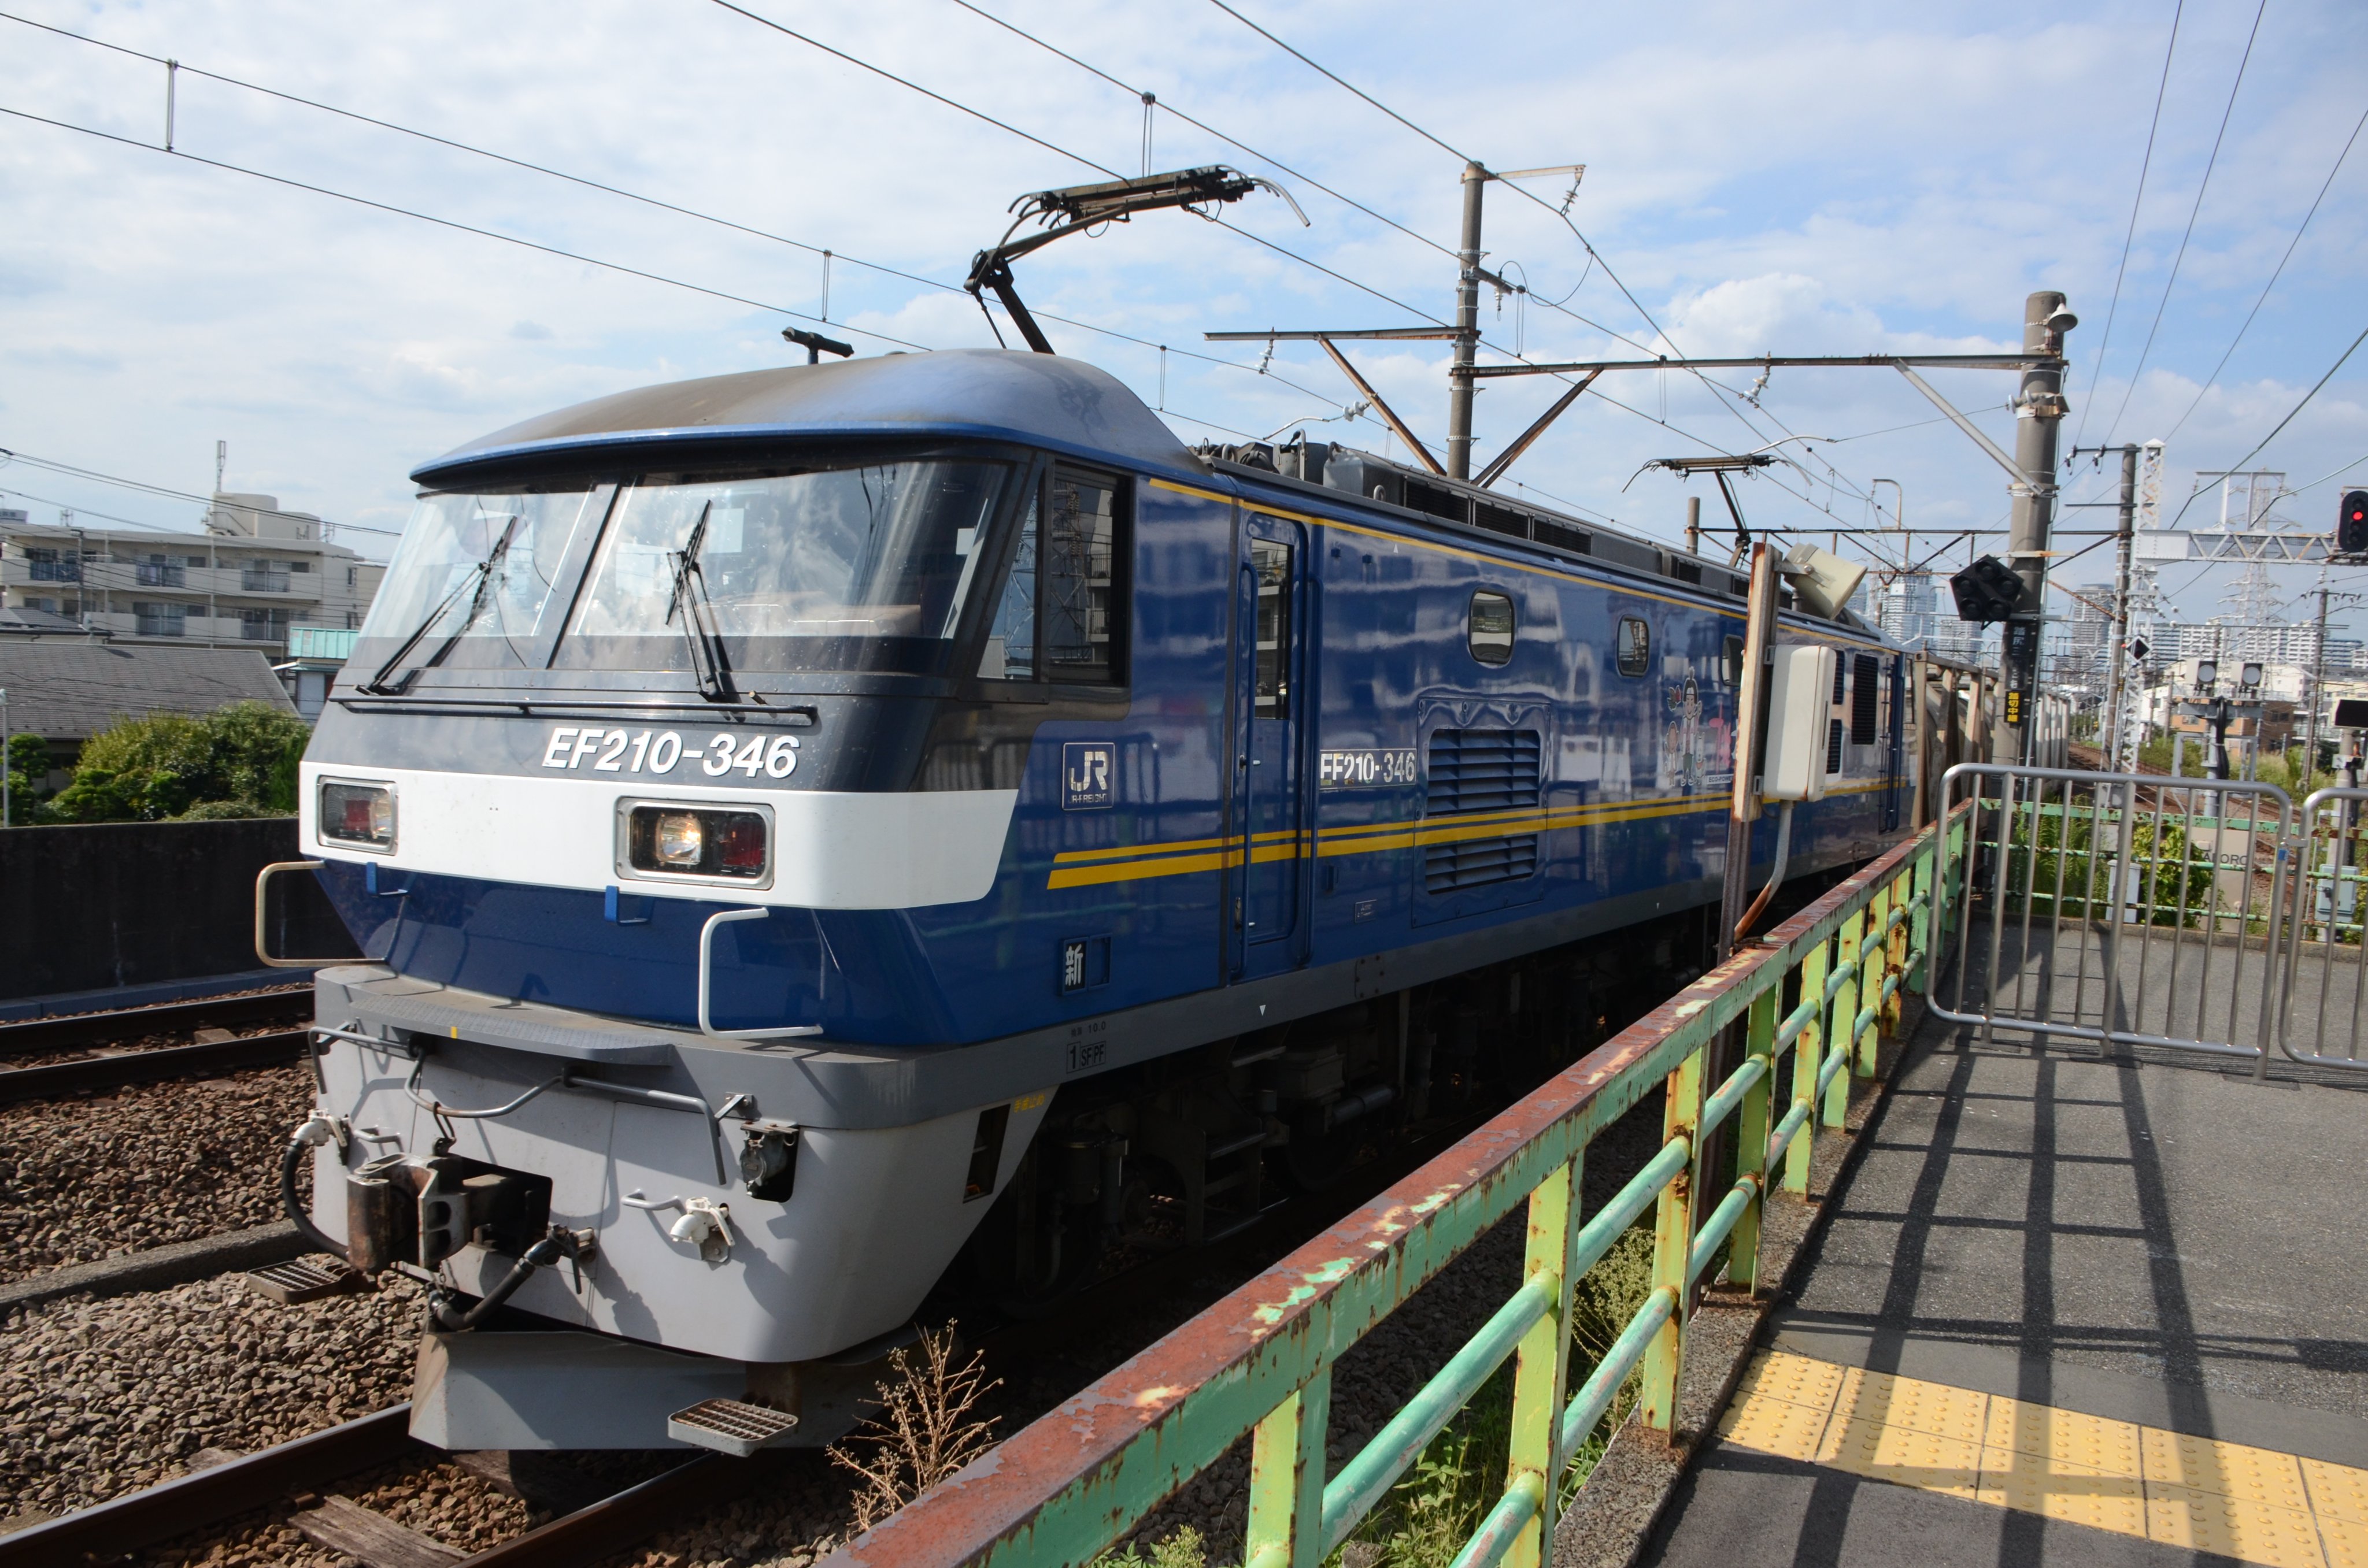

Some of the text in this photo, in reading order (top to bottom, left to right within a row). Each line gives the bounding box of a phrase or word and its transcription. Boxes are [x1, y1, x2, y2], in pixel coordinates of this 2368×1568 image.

[542, 727, 800, 779] EF210-346
[1068, 751, 1109, 792] JR
[1320, 752, 1415, 786] EF210-346
[1065, 944, 1083, 987] 新
[1088, 1021, 1106, 1033] 10.0
